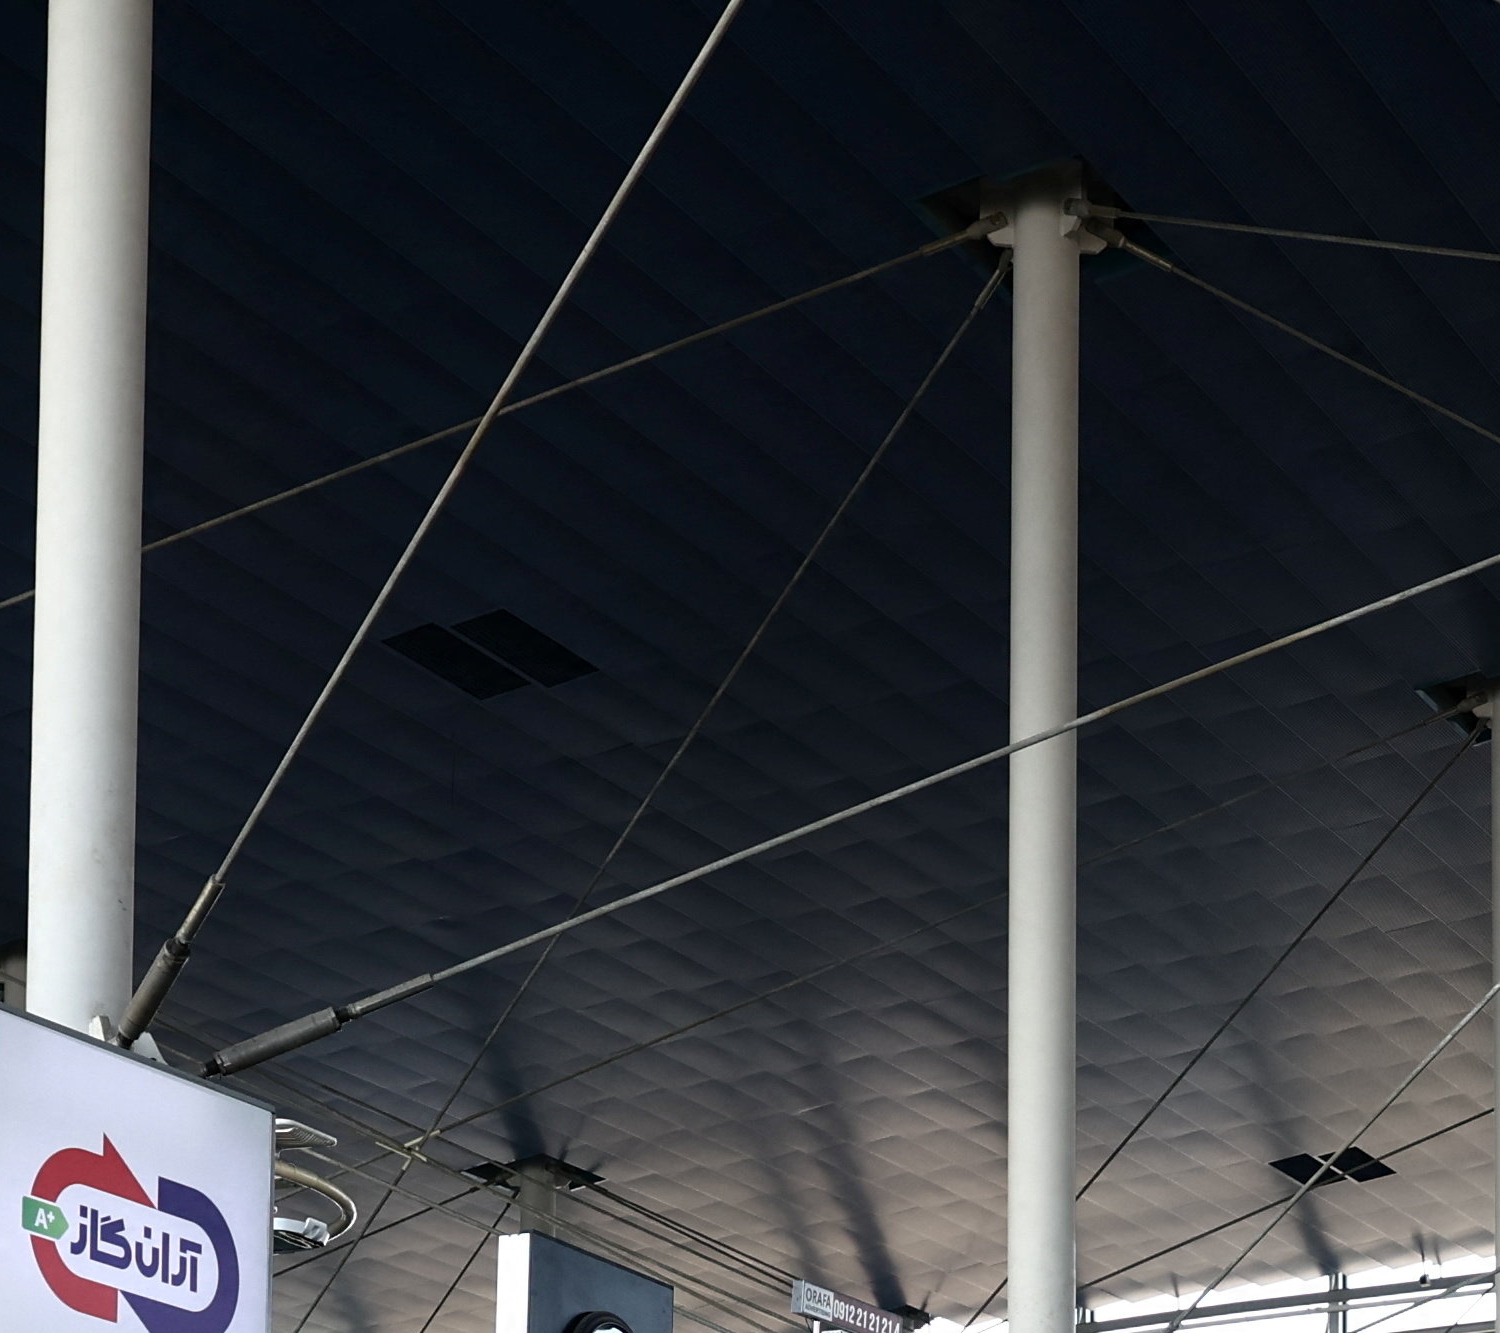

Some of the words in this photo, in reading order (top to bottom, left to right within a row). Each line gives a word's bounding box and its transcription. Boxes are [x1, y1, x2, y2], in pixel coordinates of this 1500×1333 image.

[33, 1207, 56, 1230] A+
[805, 1287, 832, 1310] ORAFA
[833, 1299, 856, 1324] 0912
